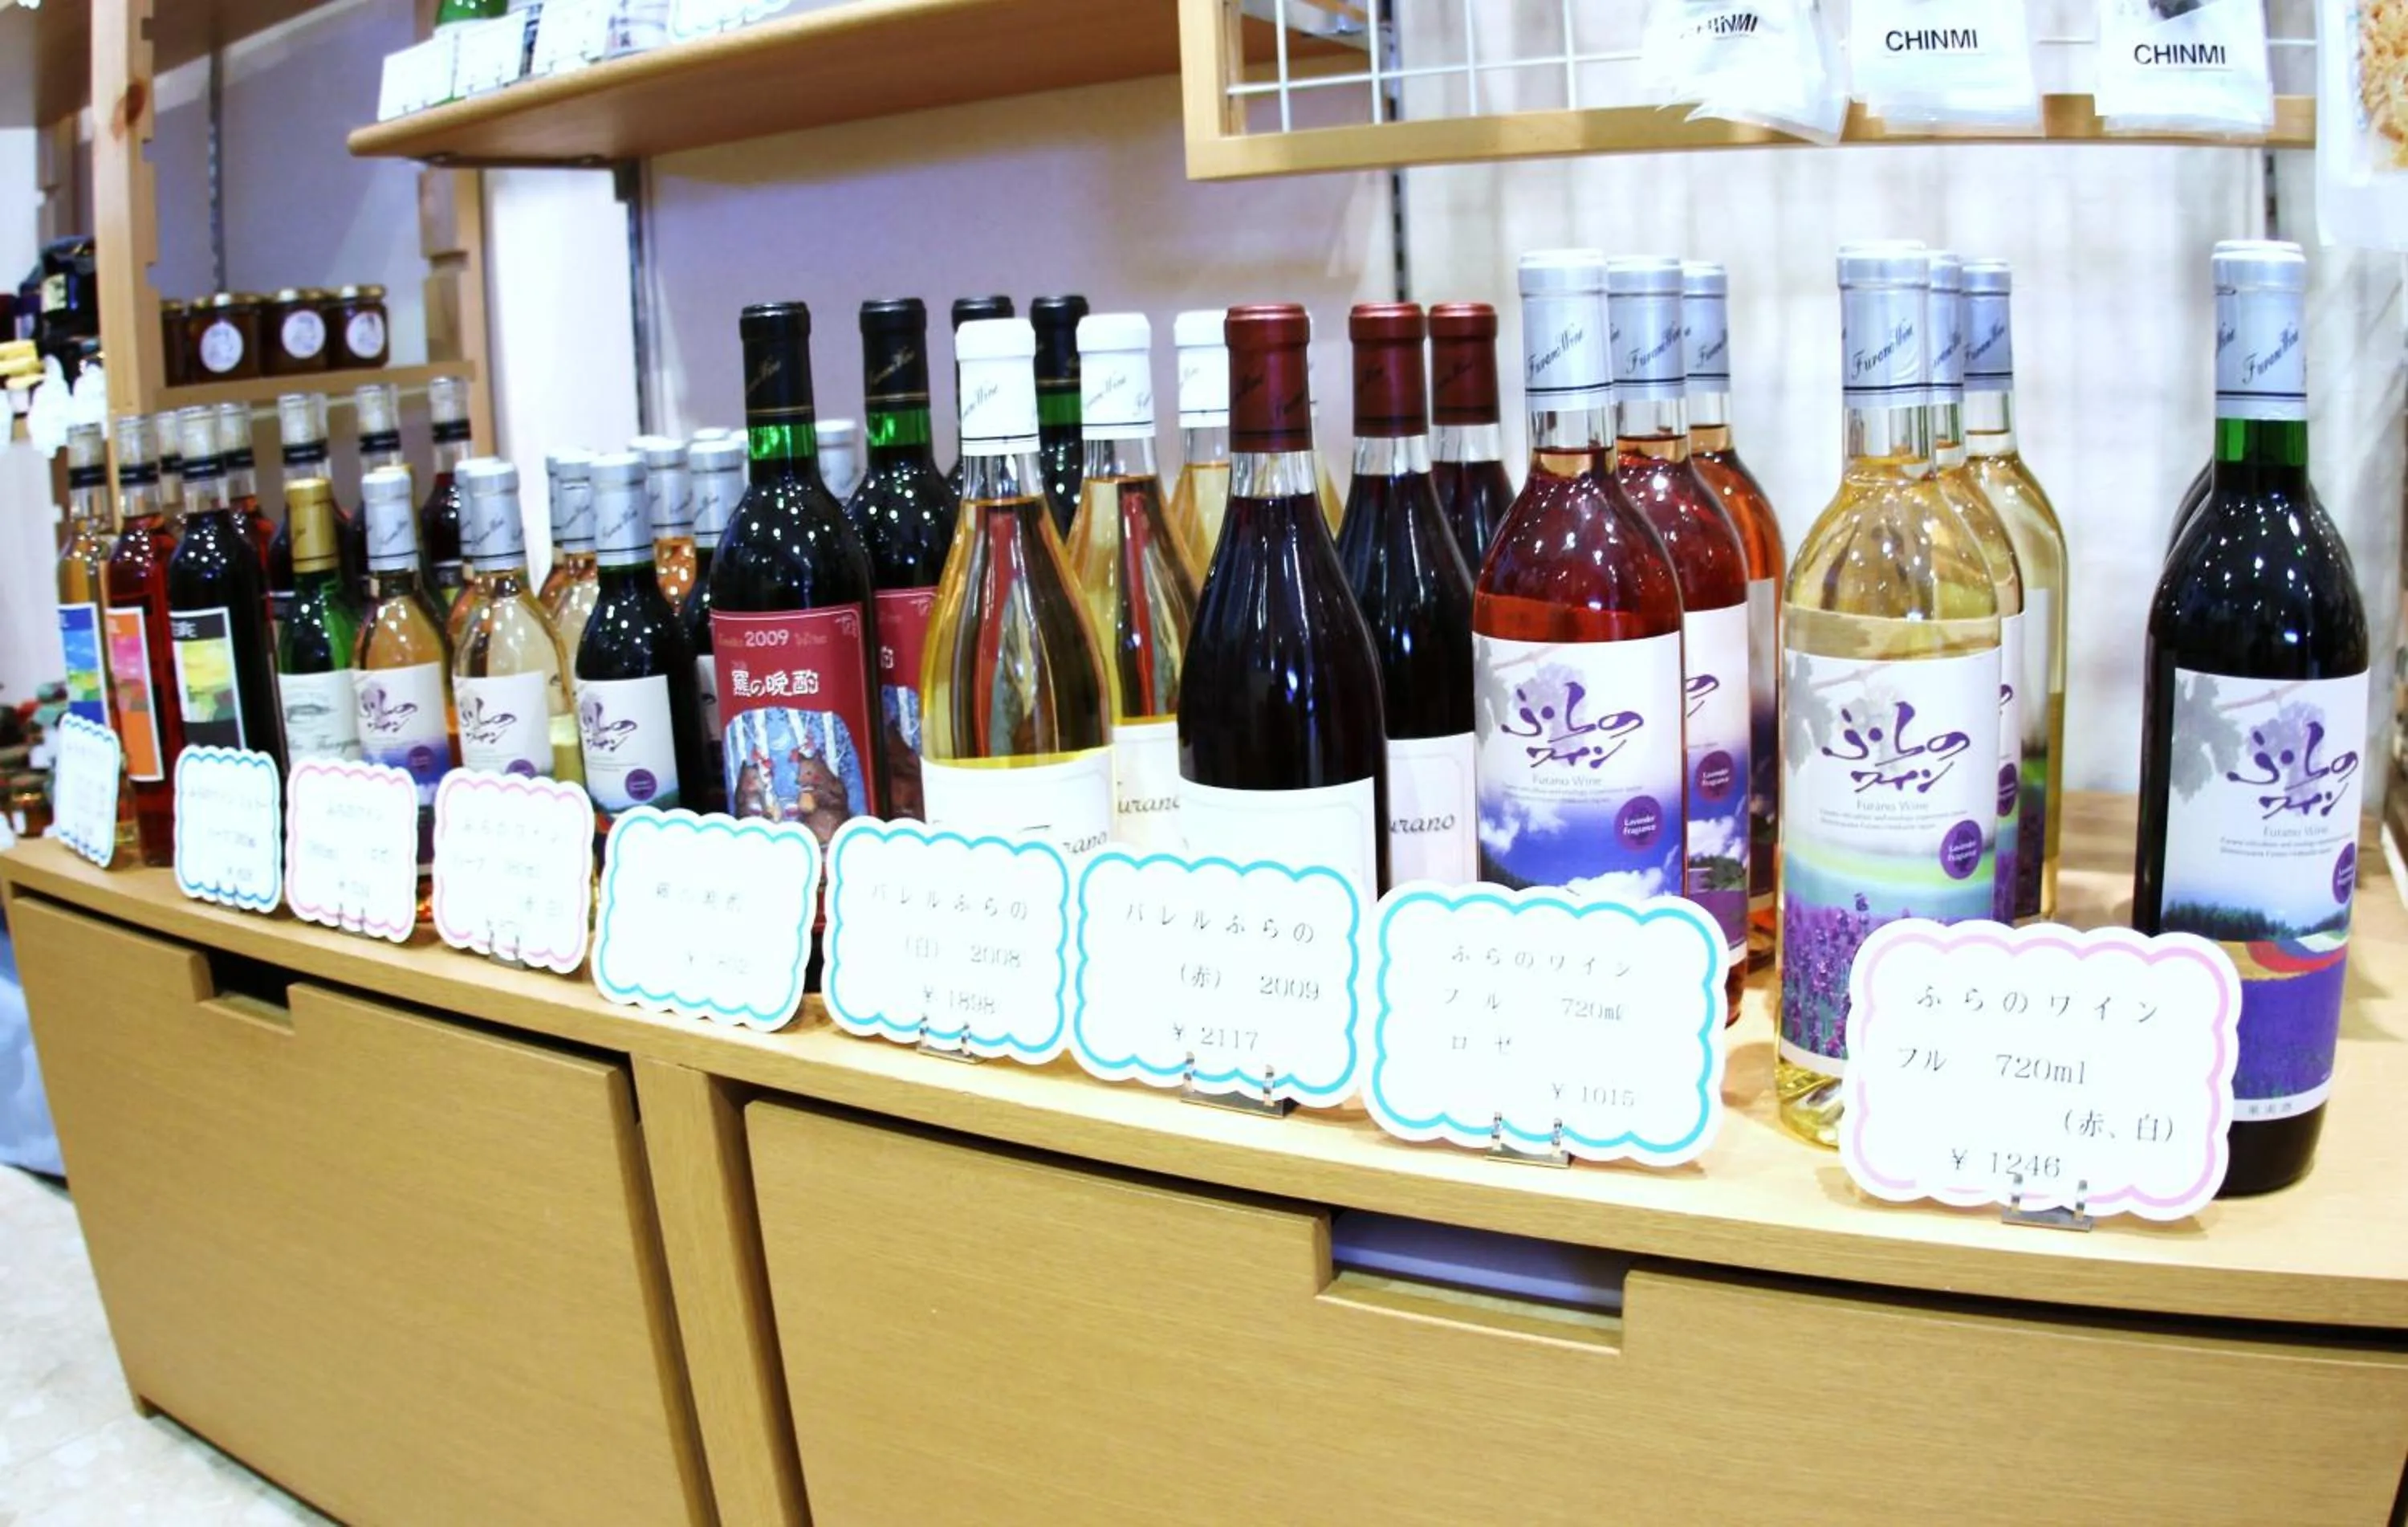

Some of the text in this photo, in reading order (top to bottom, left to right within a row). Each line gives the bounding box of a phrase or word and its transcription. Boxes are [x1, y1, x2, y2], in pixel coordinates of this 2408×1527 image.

[1885, 28, 1979, 52] CHINMI
[2133, 43, 2227, 66] CHINMI
[744, 629, 789, 647] 2009
[1450, 944, 1632, 979] ふらのワイン
[1259, 975, 1320, 1002] 2009
[1916, 984, 2159, 1024] ふらのワイン
[1199, 1026, 1259, 1051] 2117
[1898, 1048, 2086, 1086] フル 720ml
[1991, 1150, 2062, 1180] 1246
